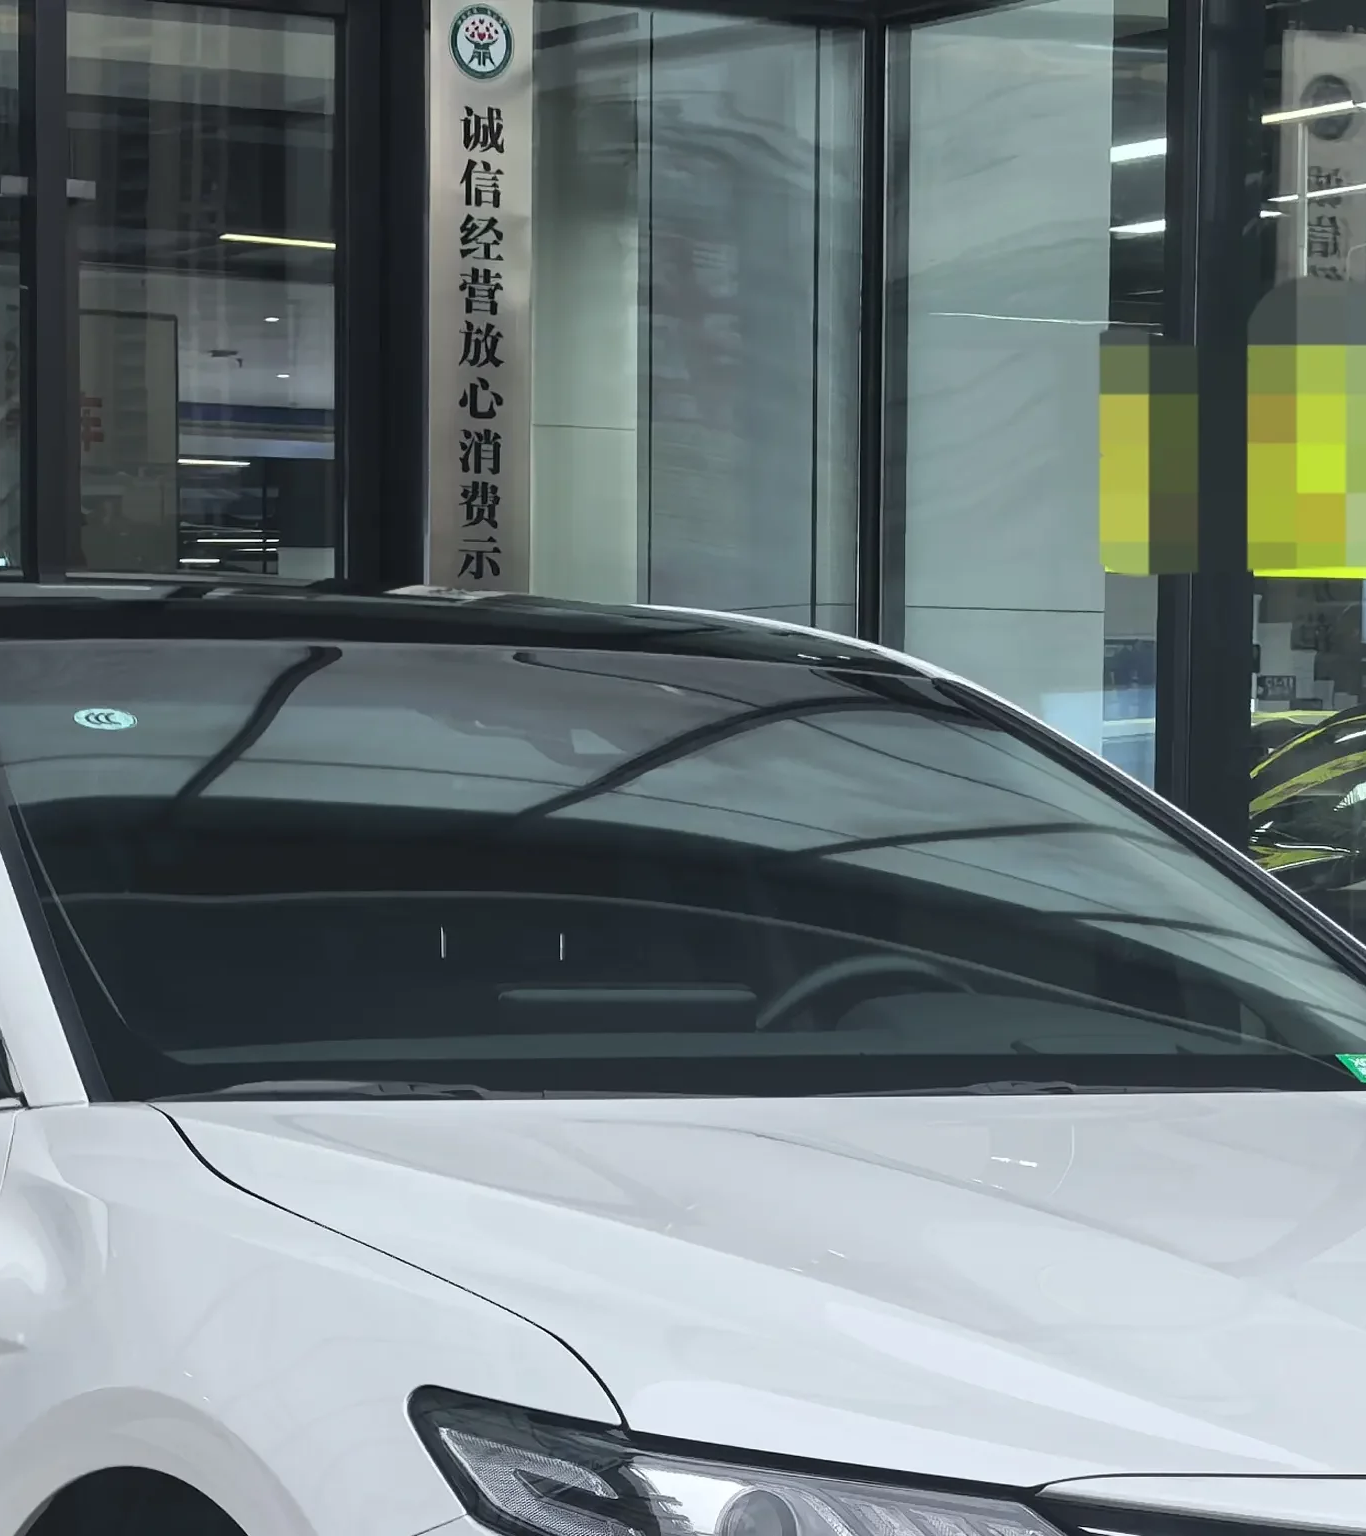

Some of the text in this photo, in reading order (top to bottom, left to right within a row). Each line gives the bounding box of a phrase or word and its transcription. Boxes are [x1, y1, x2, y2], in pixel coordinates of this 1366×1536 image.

[458, 105, 505, 580] 诚信经营放心消费示
